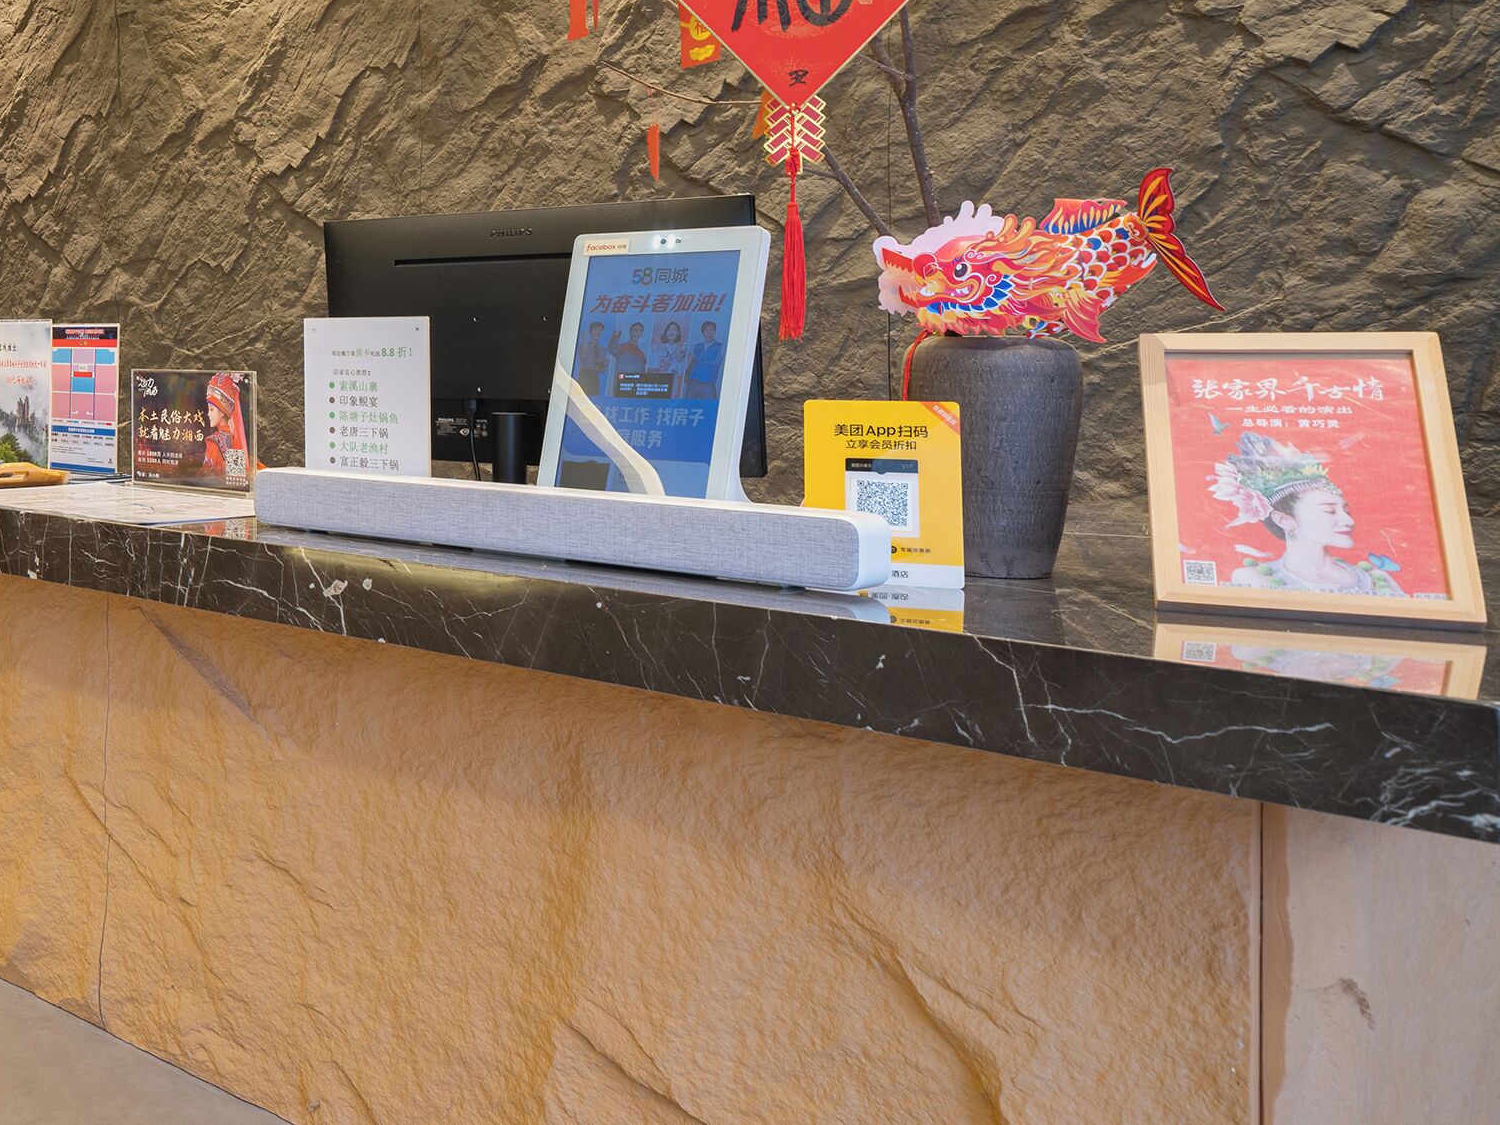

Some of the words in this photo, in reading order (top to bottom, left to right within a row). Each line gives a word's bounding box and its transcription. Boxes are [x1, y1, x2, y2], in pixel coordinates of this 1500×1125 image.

[490, 227, 533, 238] PHILIPS
[632, 267, 689, 286] 58同城
[1192, 375, 1384, 402] 张家界千古情
[138, 407, 206, 427] 本土民俗大戏
[655, 407, 705, 427] 找房子
[1226, 405, 1353, 414] 一生必看的演出
[137, 424, 205, 442] 就看魅力湘西
[834, 423, 928, 438] 美团App扫码
[846, 439, 917, 450] 立享会员折扣
